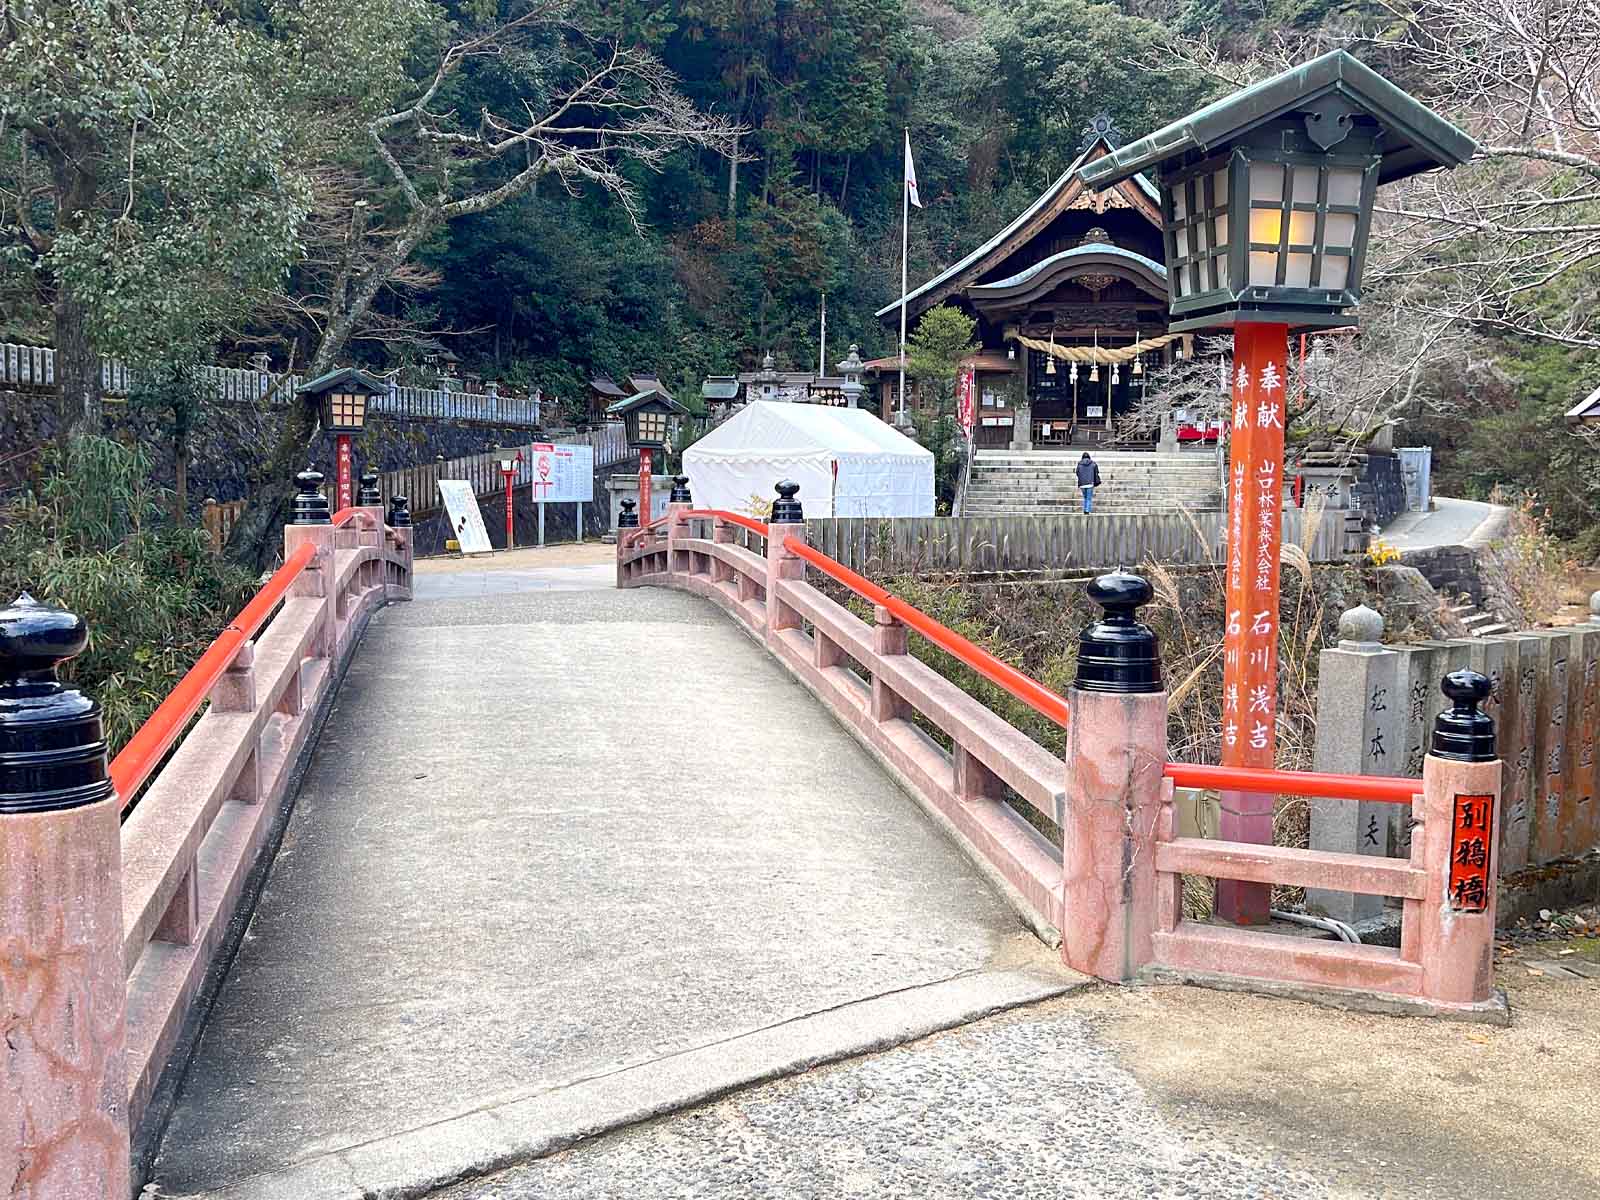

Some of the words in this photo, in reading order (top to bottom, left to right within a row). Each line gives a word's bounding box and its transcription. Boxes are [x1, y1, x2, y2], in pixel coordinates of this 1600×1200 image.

[1234, 361, 1250, 431] 奉献
[1256, 360, 1283, 430] 奉献
[1255, 459, 1276, 591] 山口林業株式会社
[1224, 609, 1241, 747] 石川浅吉
[1248, 610, 1272, 750] 石川浅吉
